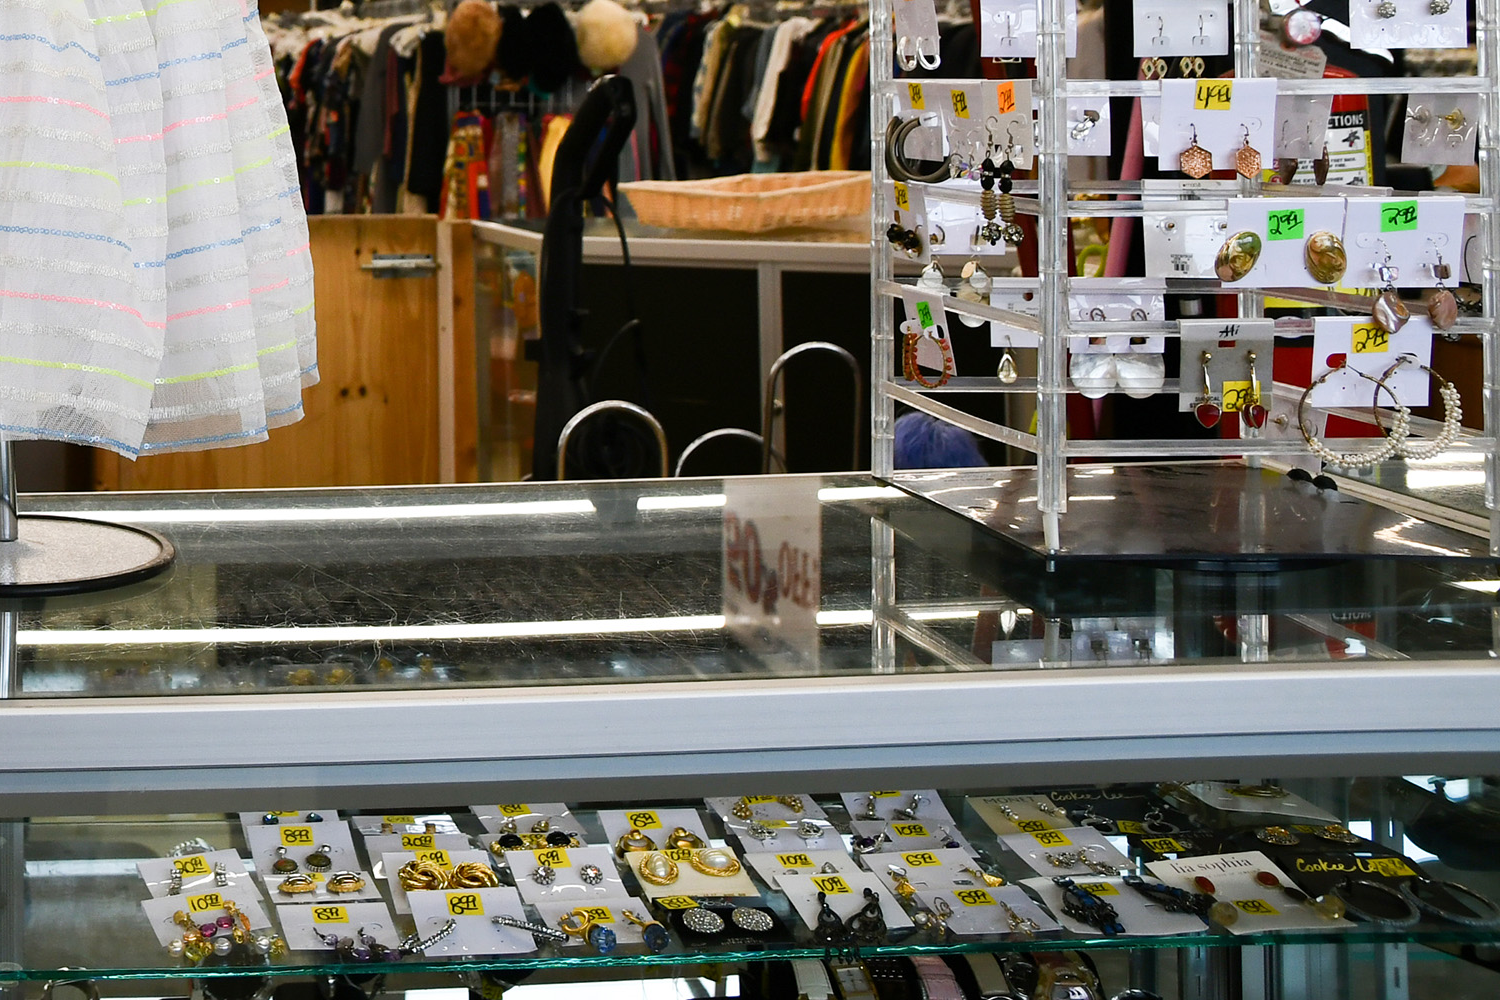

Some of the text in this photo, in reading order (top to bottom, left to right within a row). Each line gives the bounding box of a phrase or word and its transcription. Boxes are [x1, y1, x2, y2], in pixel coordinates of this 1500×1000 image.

[1197, 85, 1231, 109] 499
[1269, 211, 1303, 235] 299
[1382, 206, 1417, 225] 299
[630, 812, 657, 828] 899
[283, 829, 314, 843] 899
[1171, 857, 1253, 875] lia sophia
[814, 877, 849, 892] 1099
[191, 894, 223, 911] 1099
[450, 895, 479, 915] 899
[957, 889, 992, 904] 899
